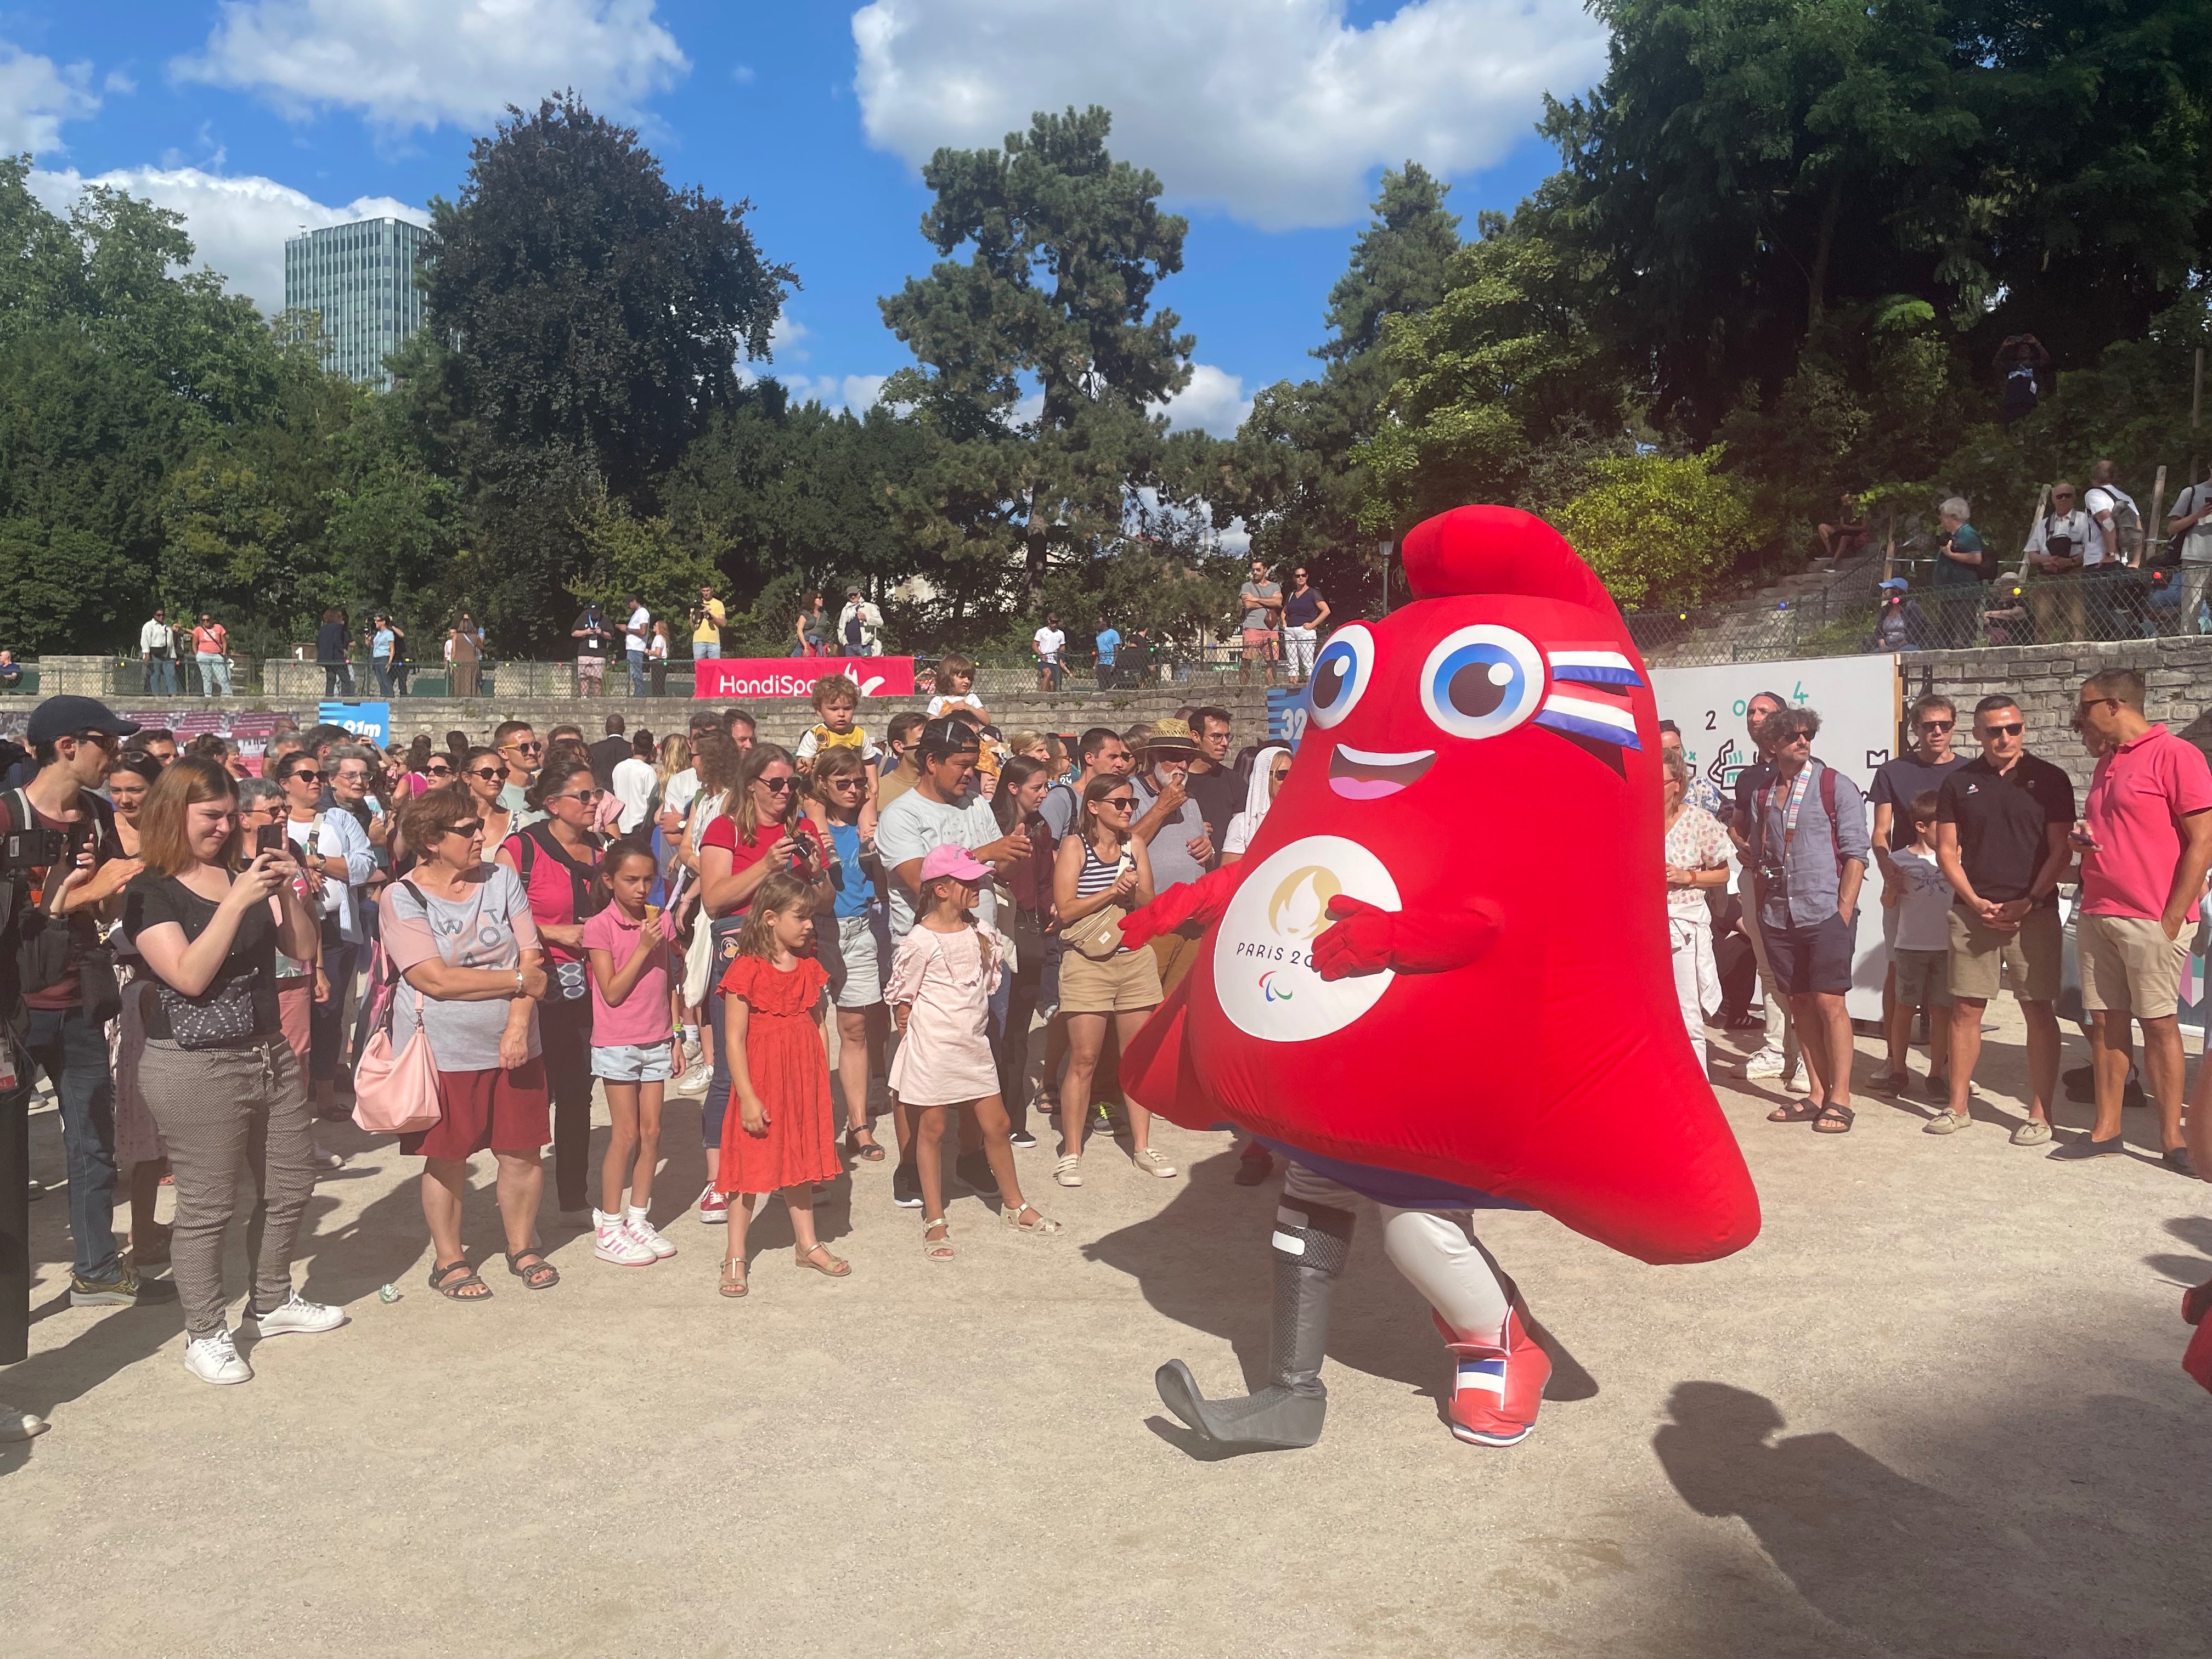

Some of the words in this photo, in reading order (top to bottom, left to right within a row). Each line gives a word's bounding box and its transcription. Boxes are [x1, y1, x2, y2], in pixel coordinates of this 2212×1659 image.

[295, 647, 303, 661] 1
[719, 674, 817, 697] HandiSpo
[1290, 951, 1314, 967] 20
